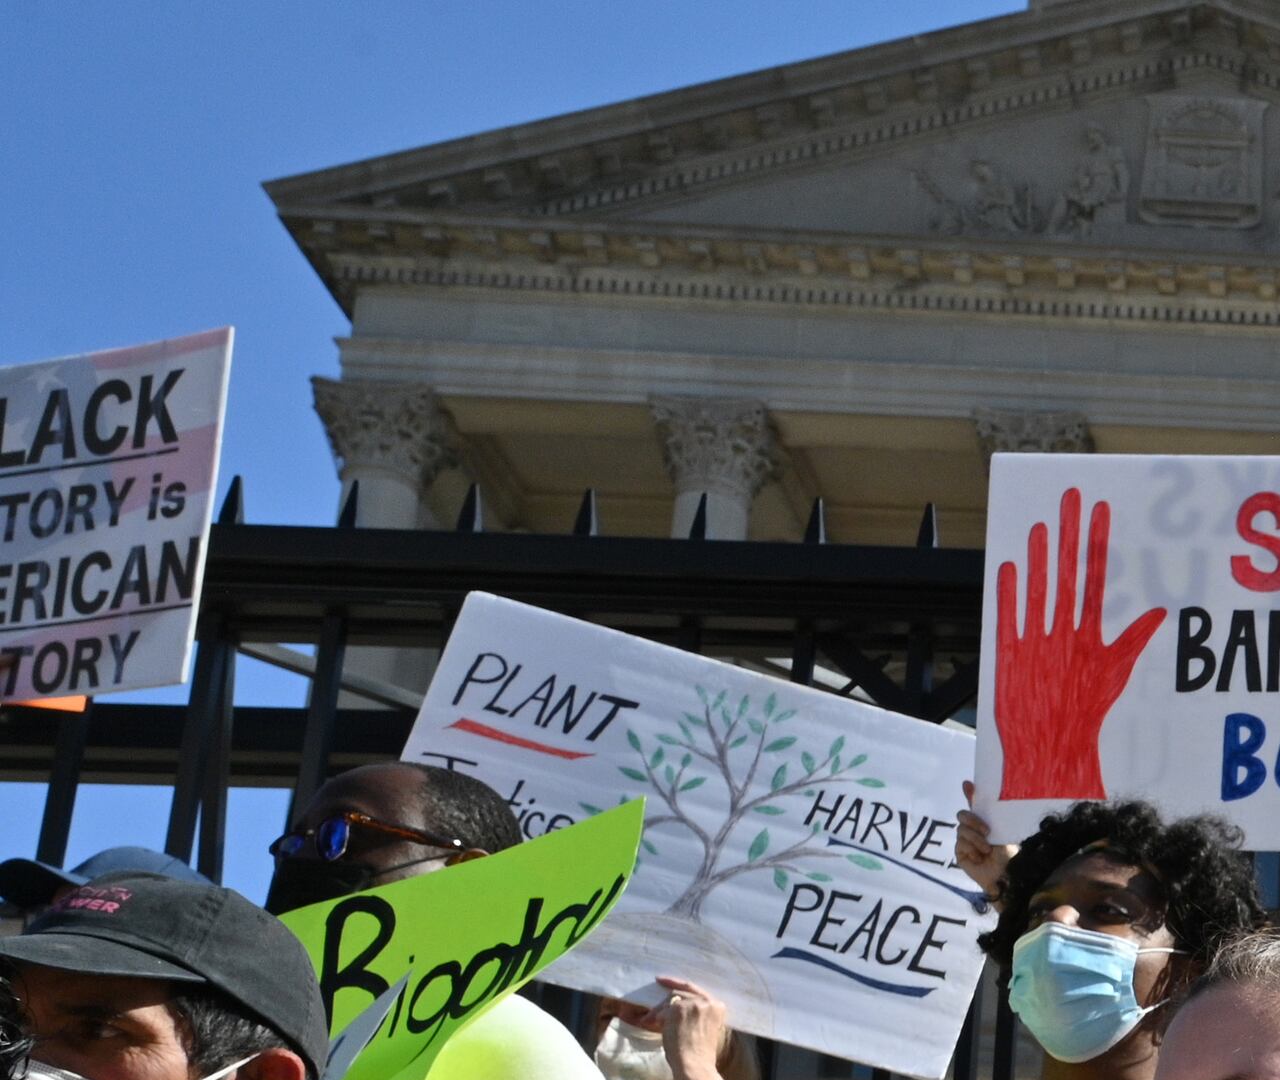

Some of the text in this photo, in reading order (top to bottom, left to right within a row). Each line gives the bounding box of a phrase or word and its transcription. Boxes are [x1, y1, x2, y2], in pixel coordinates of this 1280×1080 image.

[147, 472, 187, 521] is
[452, 652, 640, 742] PLANT
[422, 752, 576, 840] tice
[804, 789, 962, 869] HARVE
[776, 882, 967, 981] PEACE
